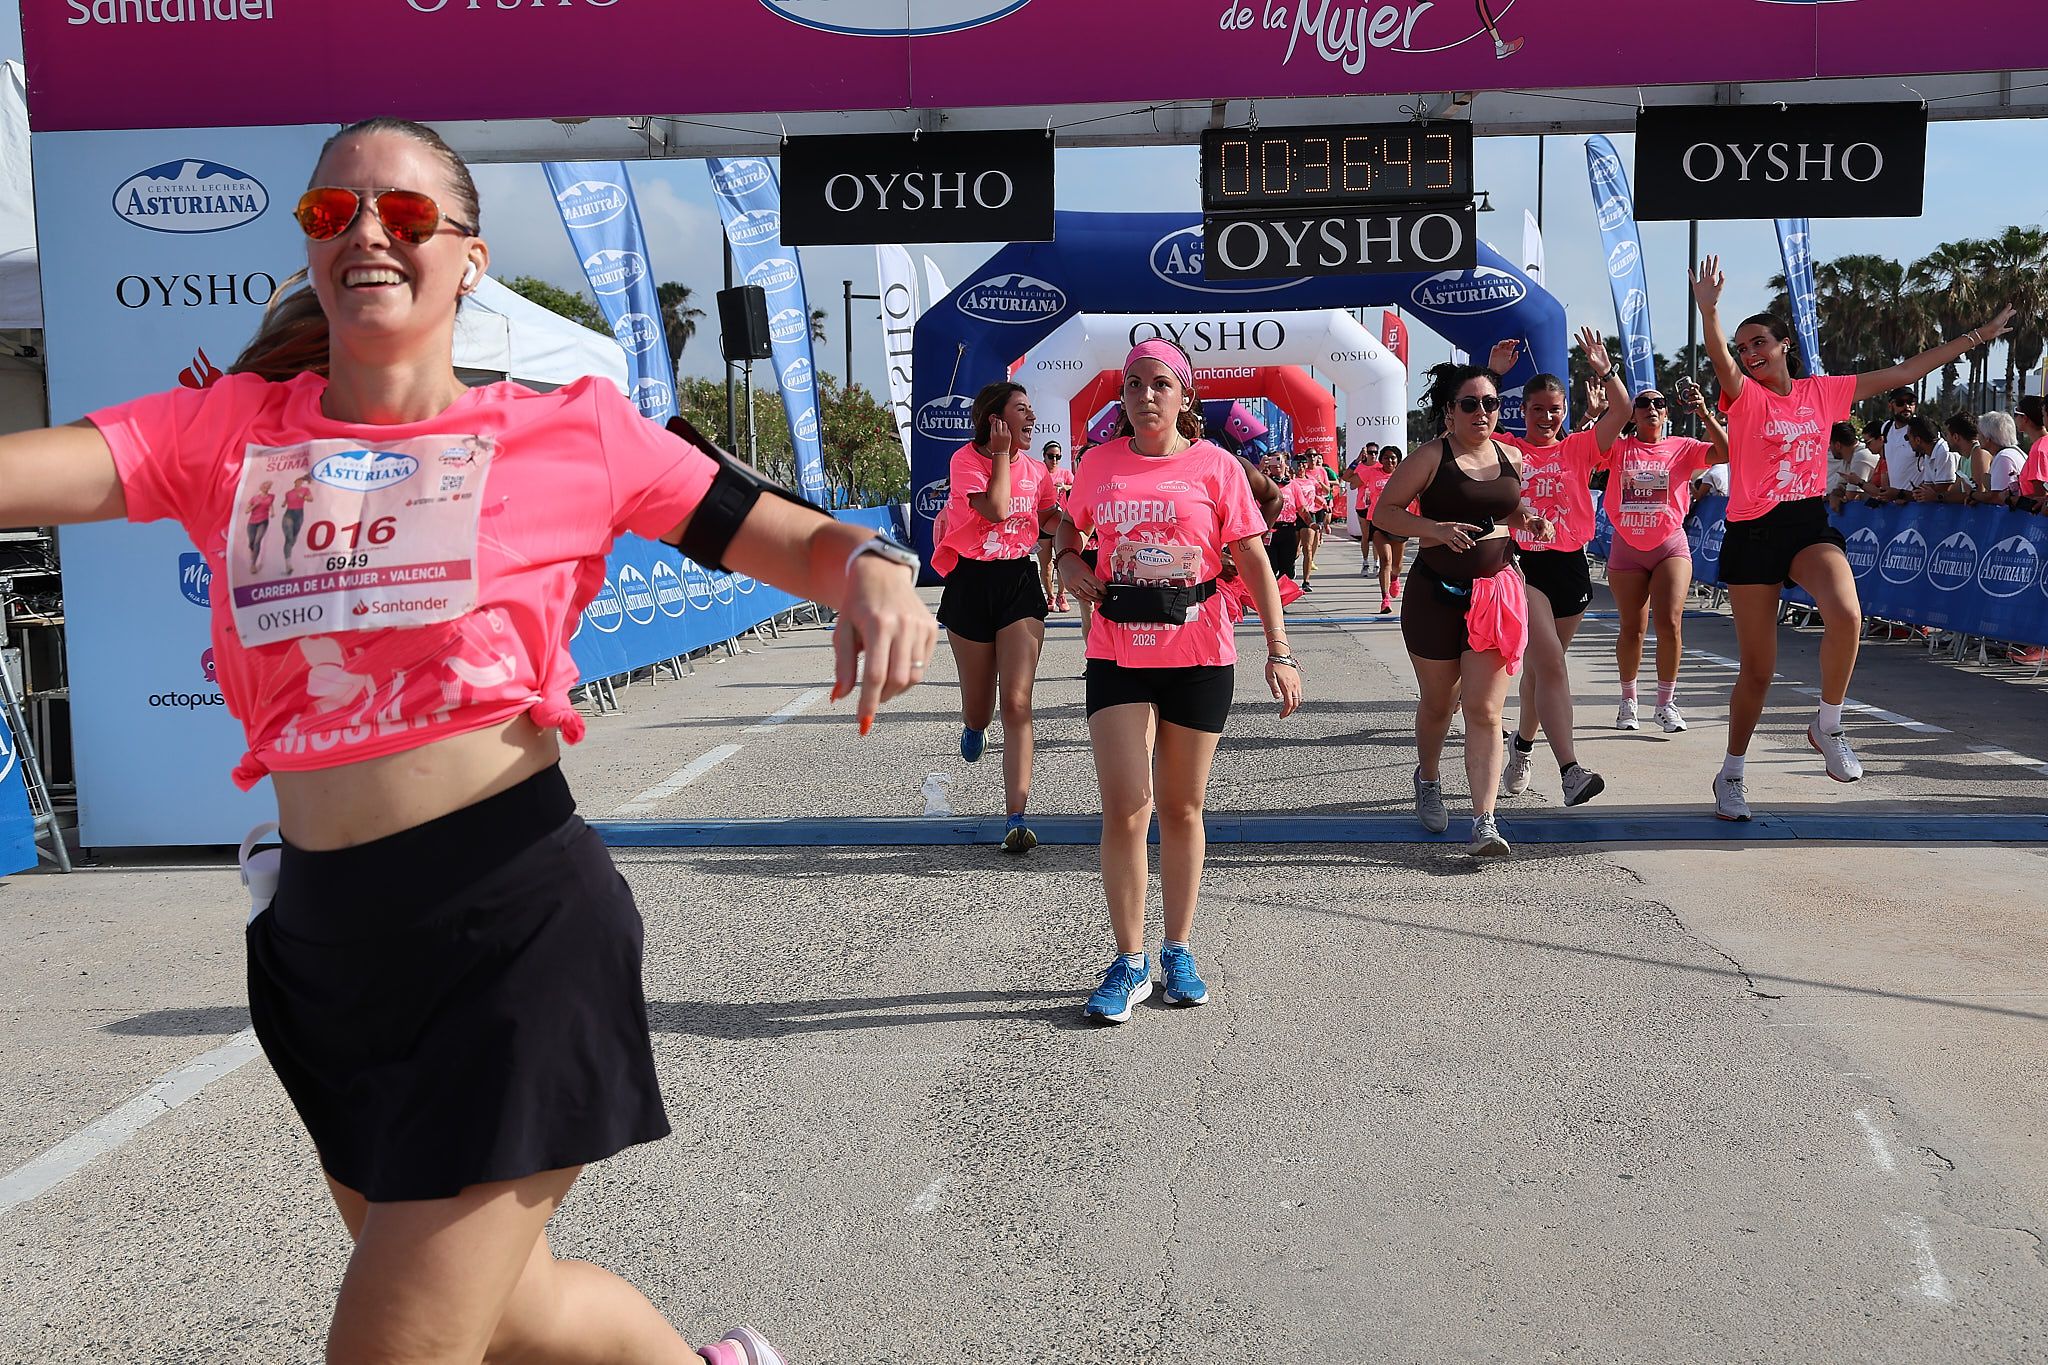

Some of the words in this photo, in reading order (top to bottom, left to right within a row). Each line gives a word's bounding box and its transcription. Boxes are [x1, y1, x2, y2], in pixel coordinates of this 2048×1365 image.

[68, 0, 273, 25] Santander
[1219, 0, 1254, 30] de
[1262, 0, 1287, 29] la
[1282, 0, 1435, 75] Mujer
[1221, 133, 1452, 195] 00:36:43
[1681, 142, 1884, 182] OYSHO
[148, 185, 198, 193] CENTRAL
[202, 183, 252, 192] LECHERA
[824, 170, 1014, 212] OYSHO
[1217, 213, 1463, 271] OYSHO
[116, 272, 278, 308] OYSHO
[1129, 319, 1285, 352] OYSHO
[1331, 350, 1377, 362] OYSHO
[1037, 360, 1083, 371] OYSHO
[1194, 366, 1256, 379] antander
[1034, 424, 1061, 434] SHO
[1356, 416, 1400, 427] OYSHO
[266, 457, 309, 472] SUMA
[1097, 482, 1127, 494] OYSHO
[1634, 488, 1653, 496] 016
[1097, 500, 1177, 525] CARRERA
[1620, 514, 1657, 527] MUJER
[306, 516, 397, 550] 016
[326, 554, 369, 571] 6949
[251, 582, 300, 601] CARRERA
[303, 578, 317, 592] DE
[321, 577, 335, 590] LA
[339, 573, 378, 589] MUJER
[390, 566, 447, 582] VALENCIA
[371, 597, 449, 614] Santander
[258, 604, 323, 631] OYSHO
[1133, 634, 1156, 646] 2026
[149, 692, 225, 710] octopus
